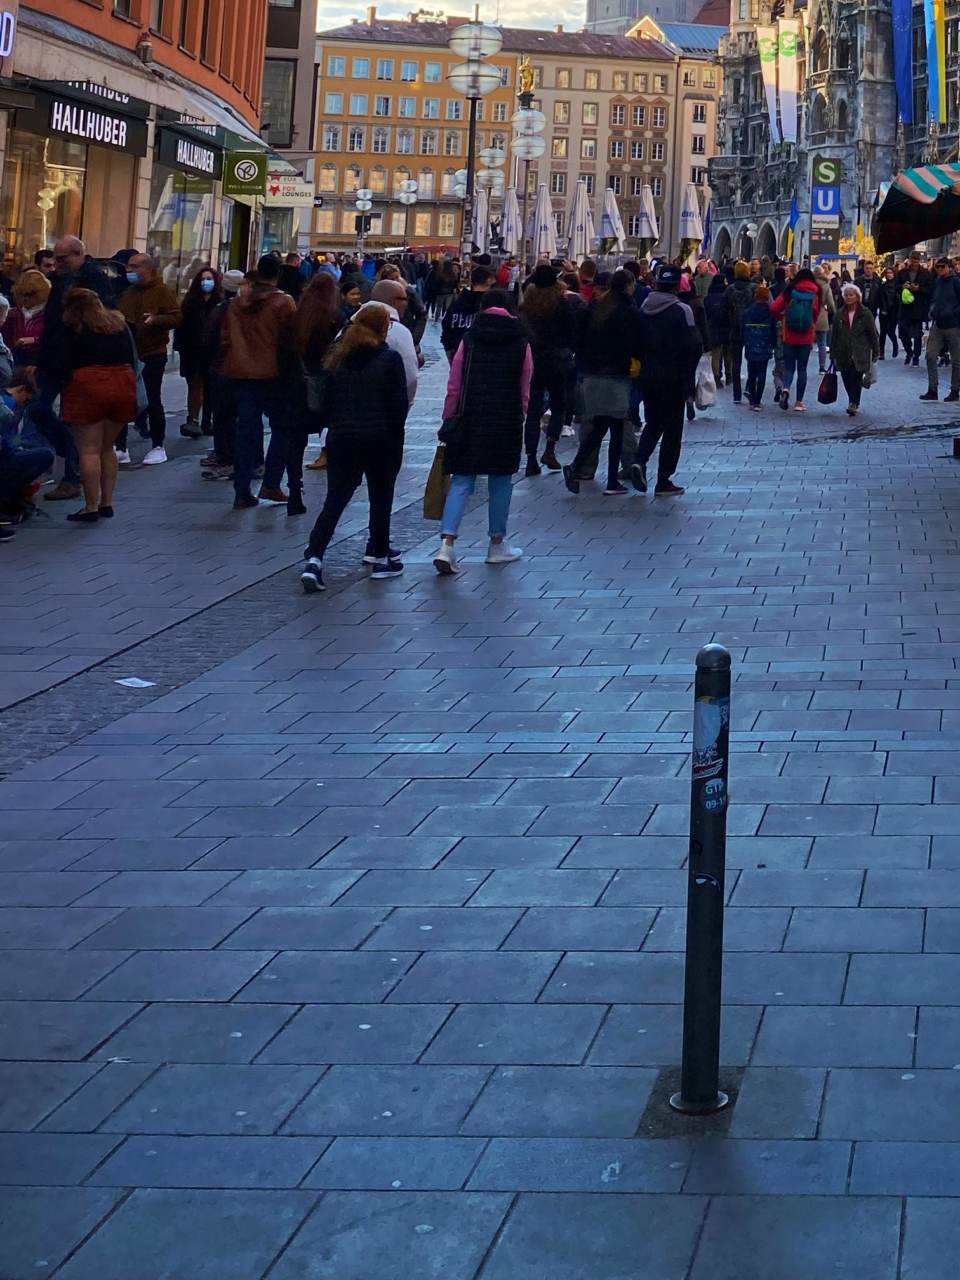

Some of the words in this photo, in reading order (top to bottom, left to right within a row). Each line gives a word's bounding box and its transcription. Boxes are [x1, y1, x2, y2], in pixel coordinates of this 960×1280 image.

[0, 11, 15, 57] D
[52, 101, 127, 147] HALLHUBER
[177, 139, 215, 174] HALLHUBER
[818, 161, 836, 183] S
[817, 190, 834, 211] U
